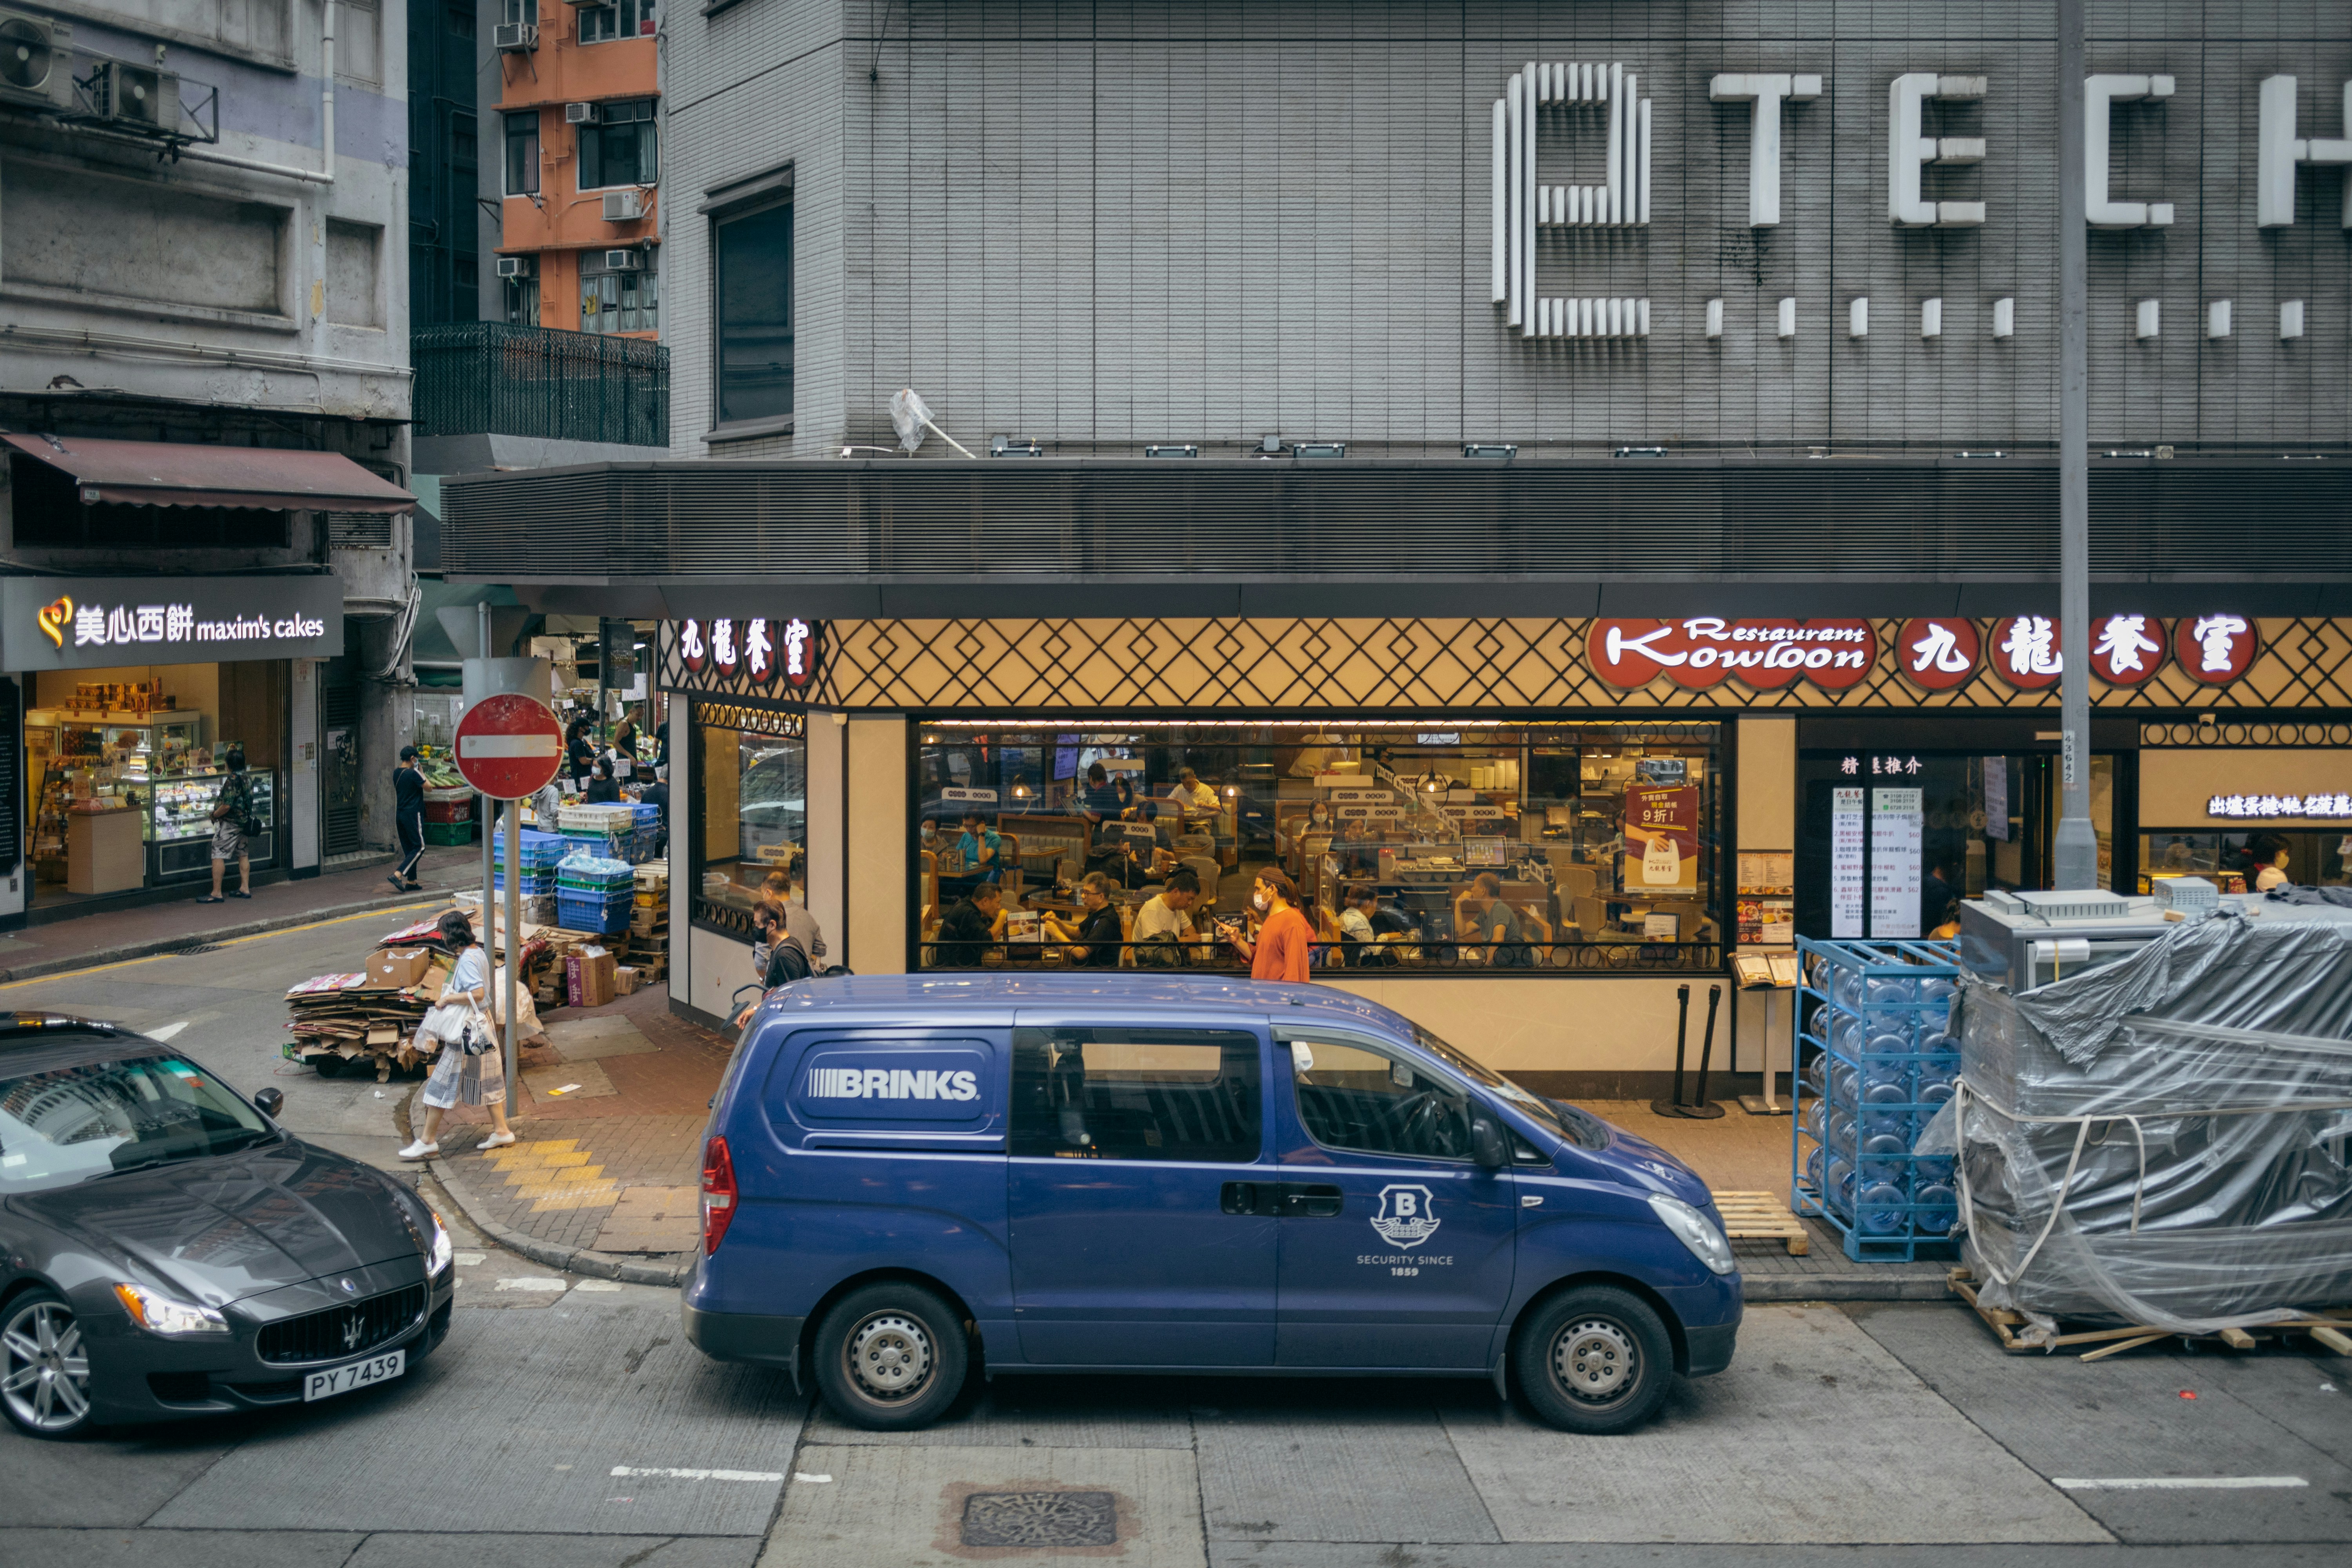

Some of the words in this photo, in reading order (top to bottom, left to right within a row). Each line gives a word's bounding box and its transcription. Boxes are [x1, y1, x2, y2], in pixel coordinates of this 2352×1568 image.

[1709, 73, 2352, 228] TECH
[75, 604, 194, 645] 美心西餅
[197, 614, 270, 641] maxim's
[275, 612, 324, 638] cakes
[1683, 618, 1866, 642] Restaurant
[681, 618, 808, 674] 九龍餐室
[1606, 626, 1865, 668] Kowloon
[1642, 793, 1668, 802] 外賣自取
[1836, 790, 1863, 799] 九龍餐
[837, 1069, 977, 1101] BRINKS
[1396, 1193, 1417, 1216] B
[1357, 1256, 1414, 1264] SECURITY
[1418, 1256, 1454, 1265] SINCE
[1391, 1267, 1419, 1276] 1859
[312, 1371, 340, 1397] PY
[346, 1355, 398, 1387] 7439
